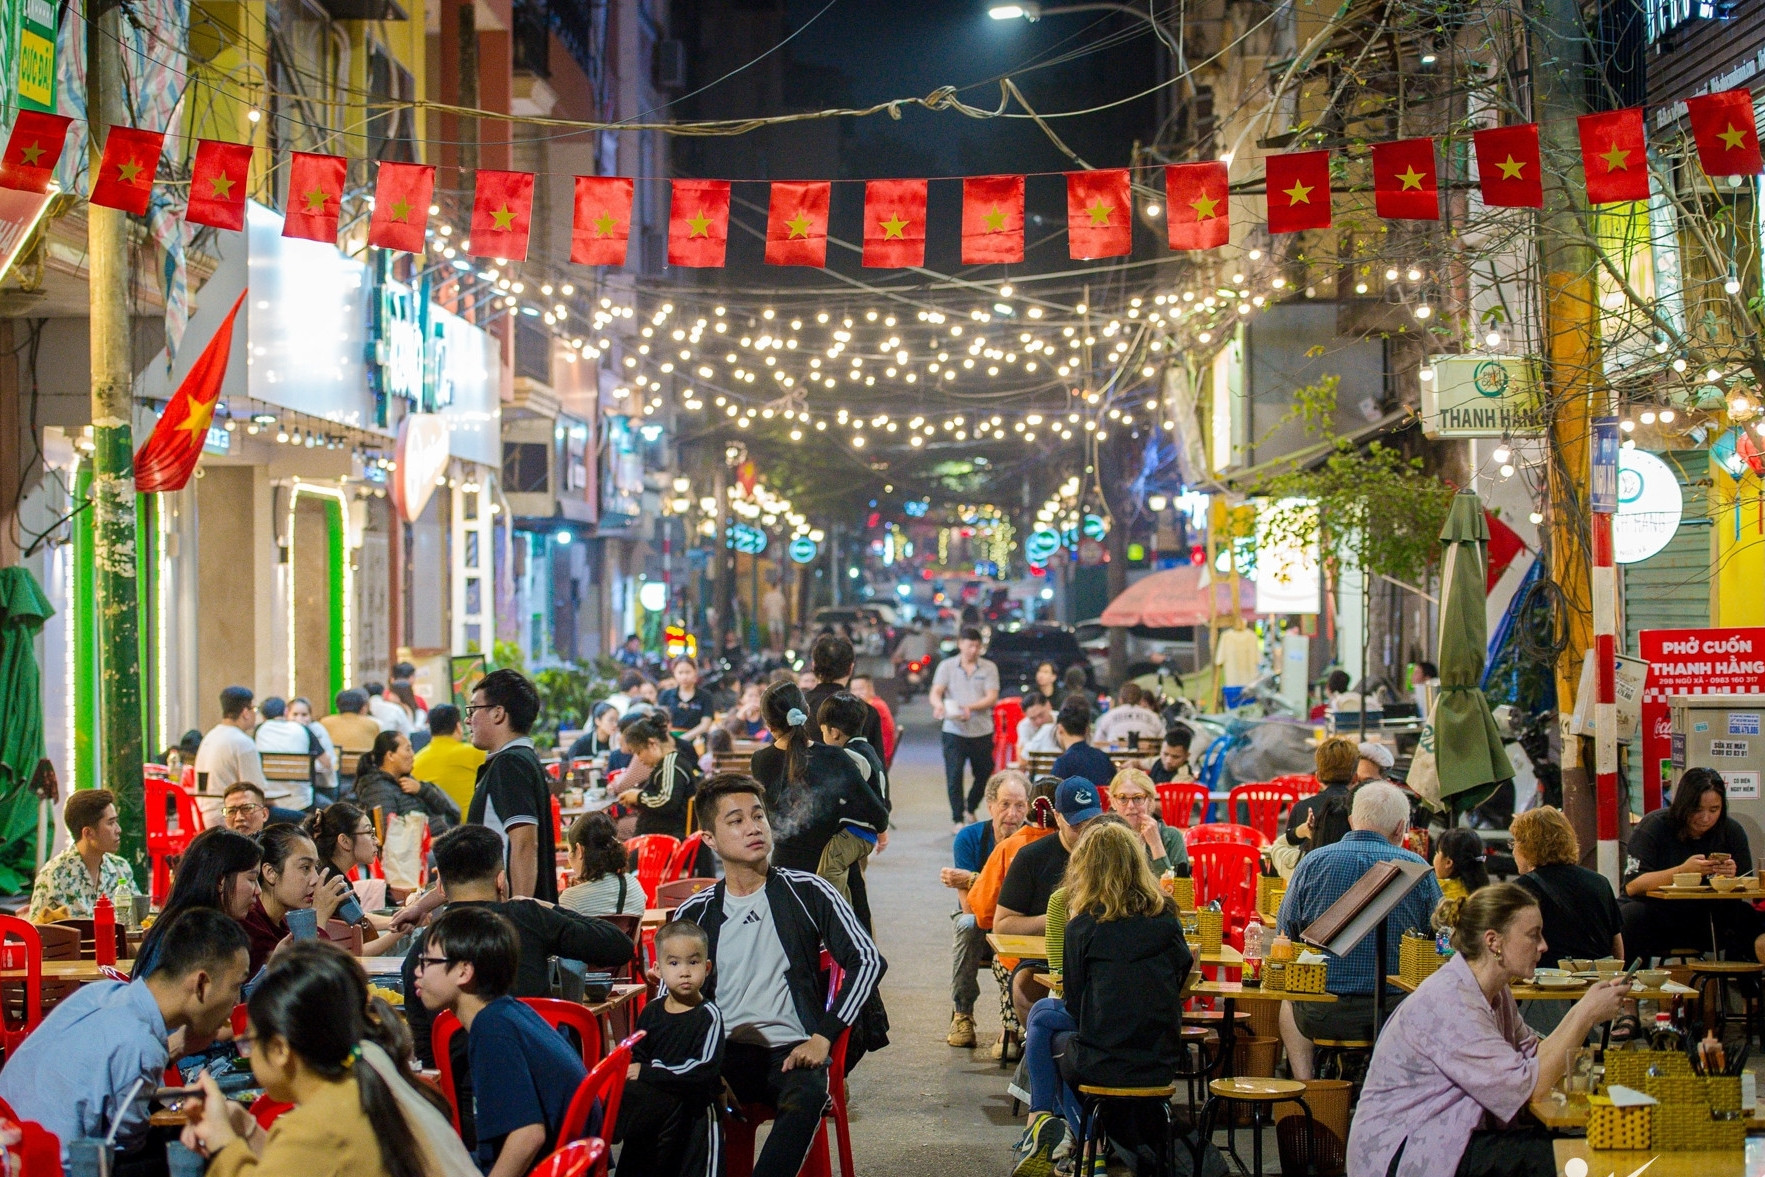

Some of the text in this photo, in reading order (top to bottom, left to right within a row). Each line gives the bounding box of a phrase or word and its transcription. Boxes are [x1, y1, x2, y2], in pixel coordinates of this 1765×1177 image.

[1440, 408, 1495, 429] THANH
[1662, 635, 1752, 655] PHỞ CUỐN
[1650, 655, 1765, 676] THANH HẰNG
